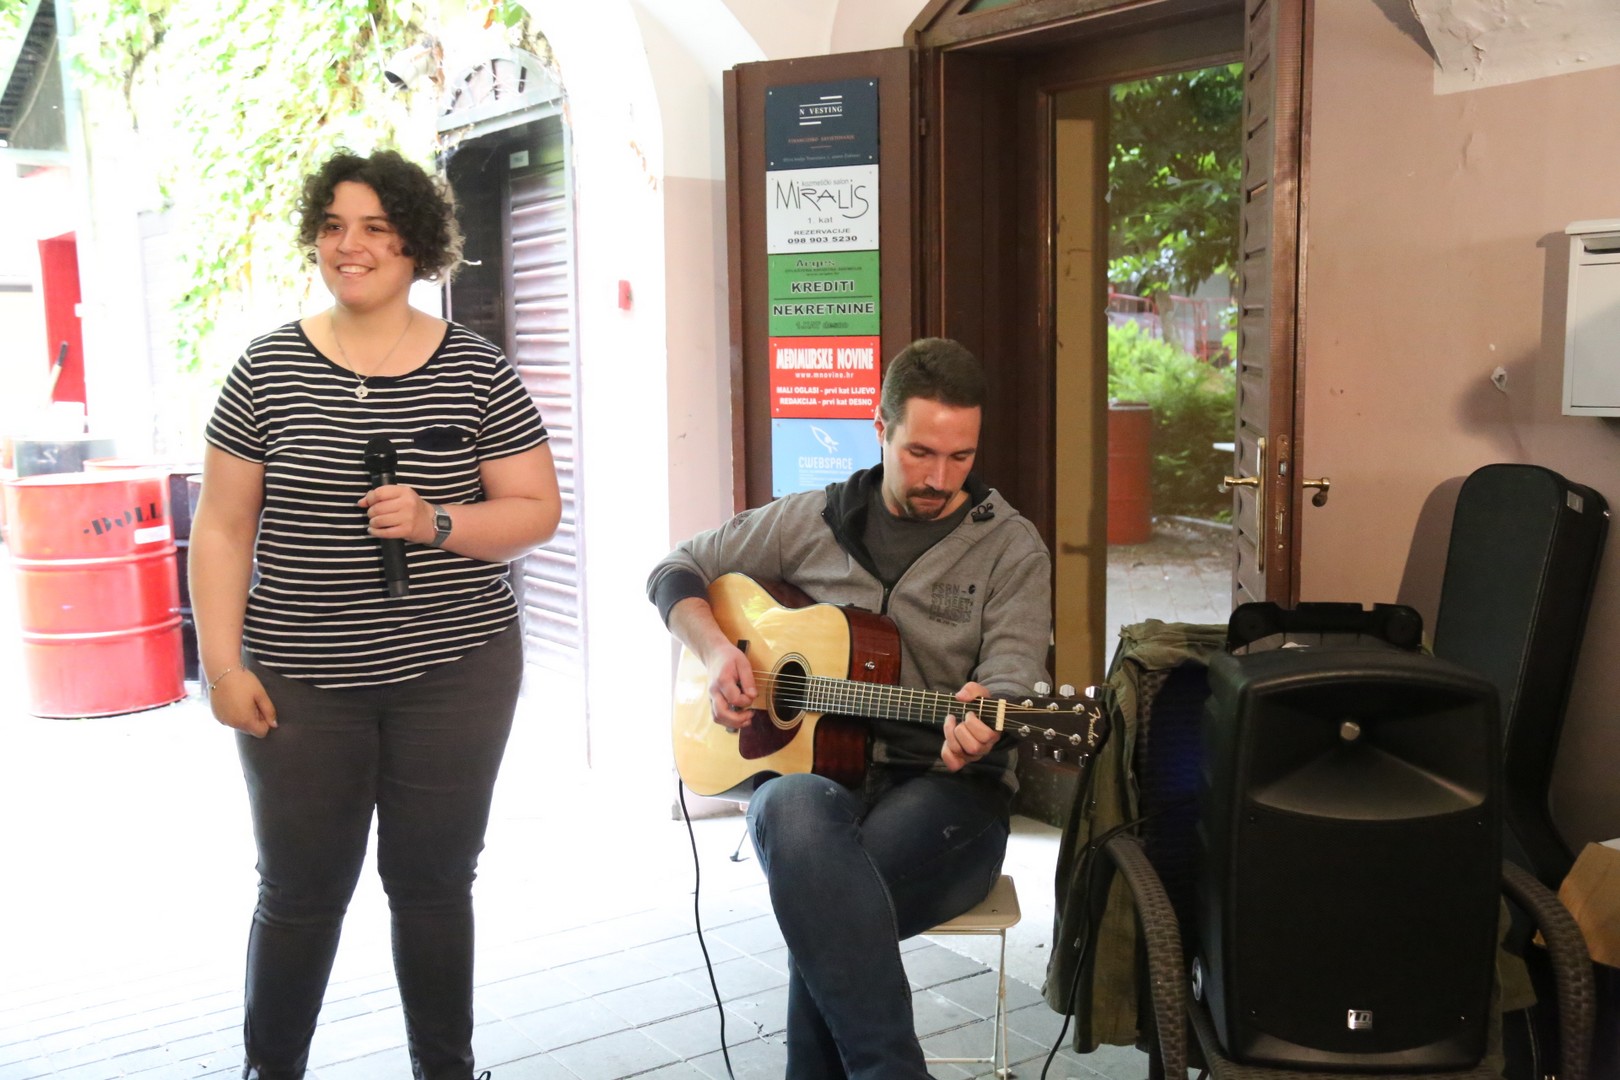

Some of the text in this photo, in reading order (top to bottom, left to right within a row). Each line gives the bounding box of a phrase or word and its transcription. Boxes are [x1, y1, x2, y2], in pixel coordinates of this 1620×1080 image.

[809, 105, 843, 115] VESTING
[818, 216, 833, 224] kat
[793, 228, 851, 236] REZERVACIJE
[787, 235, 858, 245] 098 903 5230
[791, 280, 855, 293] KREDITI
[773, 302, 875, 316] NEKRETNINE
[837, 348, 874, 369] NOVINE
[776, 386, 793, 394] MALI
[794, 386, 819, 394] OGLASI
[824, 387, 838, 395] prvi
[779, 397, 817, 405] REDAKCIJA
[822, 398, 835, 406] prvi
[848, 398, 873, 406] DESNO
[798, 456, 853, 470] CWEBSPACE
